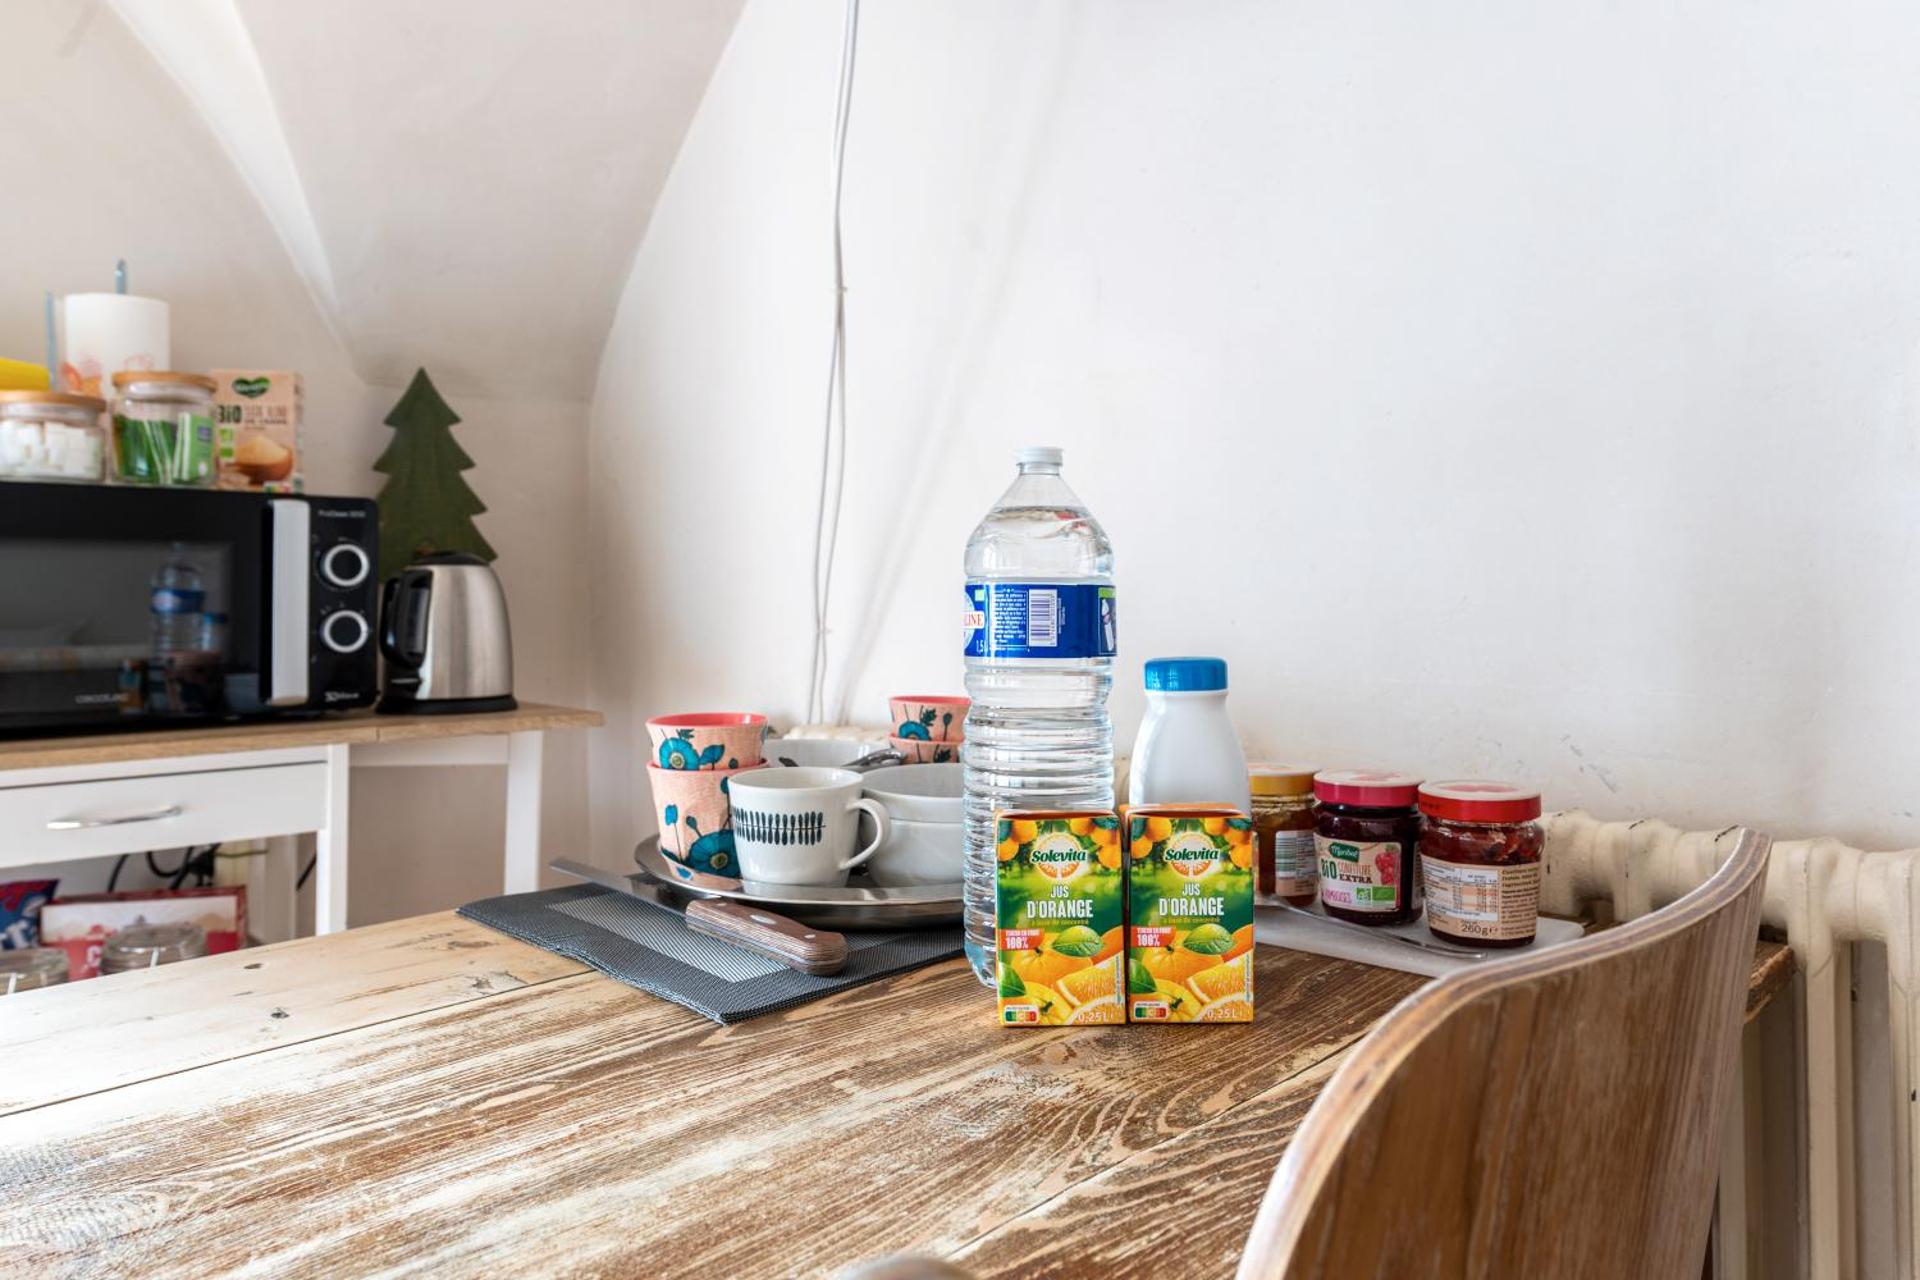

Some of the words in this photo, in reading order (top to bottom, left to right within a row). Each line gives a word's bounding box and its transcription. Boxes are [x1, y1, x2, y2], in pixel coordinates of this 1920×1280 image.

[1031, 848, 1087, 864] Solevita
[1165, 847, 1219, 862] Solevita
[1339, 874, 1373, 884] EXTRA
[1050, 885, 1069, 898] JUS
[1181, 883, 1201, 896] JUS
[1026, 899, 1094, 918] D'ORANGE
[1158, 897, 1225, 916] D'ORANGE
[1005, 936, 1029, 949] 100%
[1137, 934, 1160, 947] 100%
